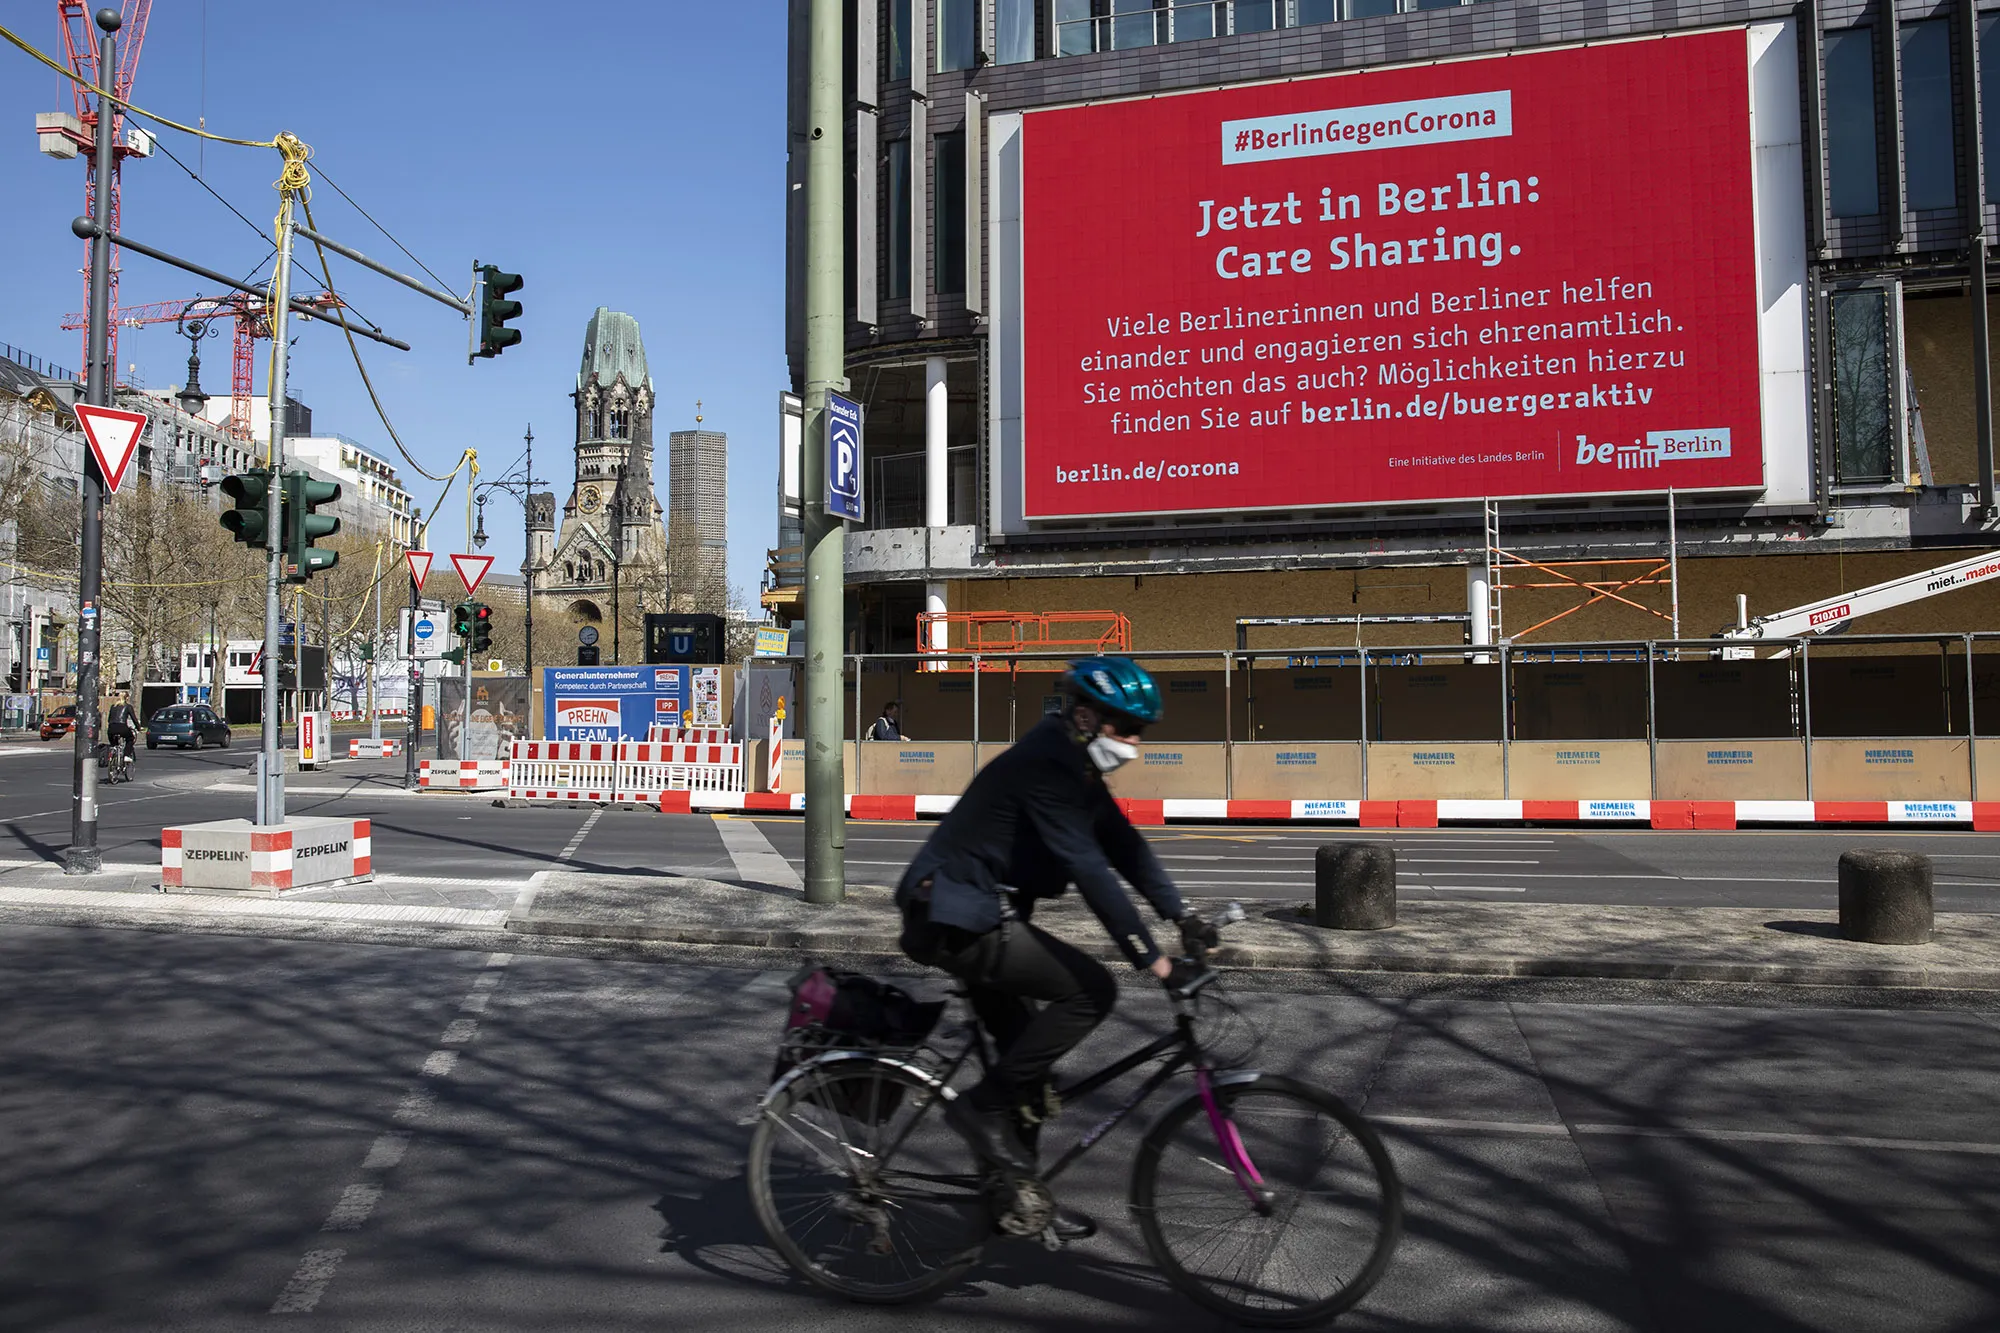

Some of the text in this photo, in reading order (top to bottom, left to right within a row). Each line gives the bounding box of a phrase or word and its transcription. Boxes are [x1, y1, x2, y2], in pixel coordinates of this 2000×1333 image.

[1234, 107, 1497, 152] #BerlinGegenCorona
[1196, 171, 1540, 237] Jetzt in Berlin:
[1215, 226, 1521, 279] Care Sharing.
[1107, 276, 1652, 338] Viele Berlinerinnen und Berliner helfen
[1080, 309, 1684, 372] einander und engagieren sich ehrenamtlich.
[1083, 348, 1685, 404] Sie möchten das auch? Möglichkeiten hierzu
[1110, 382, 1654, 435] finden Sie auf berlin.de/buergeraktiv
[1388, 449, 1545, 467] Eine Initiative des Landes Berlin
[1575, 435, 1723, 465] be Berlin
[837, 440, 853, 487] P
[1055, 459, 1240, 484] berlin.de/corona
[1812, 607, 1840, 625] 210XT
[40, 648, 49, 659] U
[674, 636, 689, 654] U
[554, 671, 639, 680] Generalunternehmer
[554, 682, 588, 690] Kompetenz
[589, 681, 607, 690] durch
[608, 681, 648, 690] Partnerschaft
[567, 709, 609, 725] PREHN
[569, 728, 608, 741] TEAM
[1144, 752, 1183, 760] NIEMEIER
[1412, 751, 1455, 760] NIEMEIER
[1556, 751, 1601, 759] NIEMEIER
[1707, 750, 1754, 759] NIEMEIER
[1864, 749, 1914, 758] NIEMEIER
[1304, 801, 1346, 809] NIEMEIER
[1589, 802, 1636, 810] NIEMEIER
[1904, 803, 1957, 811] NIEMEIER
[186, 849, 245, 862] ZEPPELIN
[296, 840, 348, 859] ZEPPELIN
